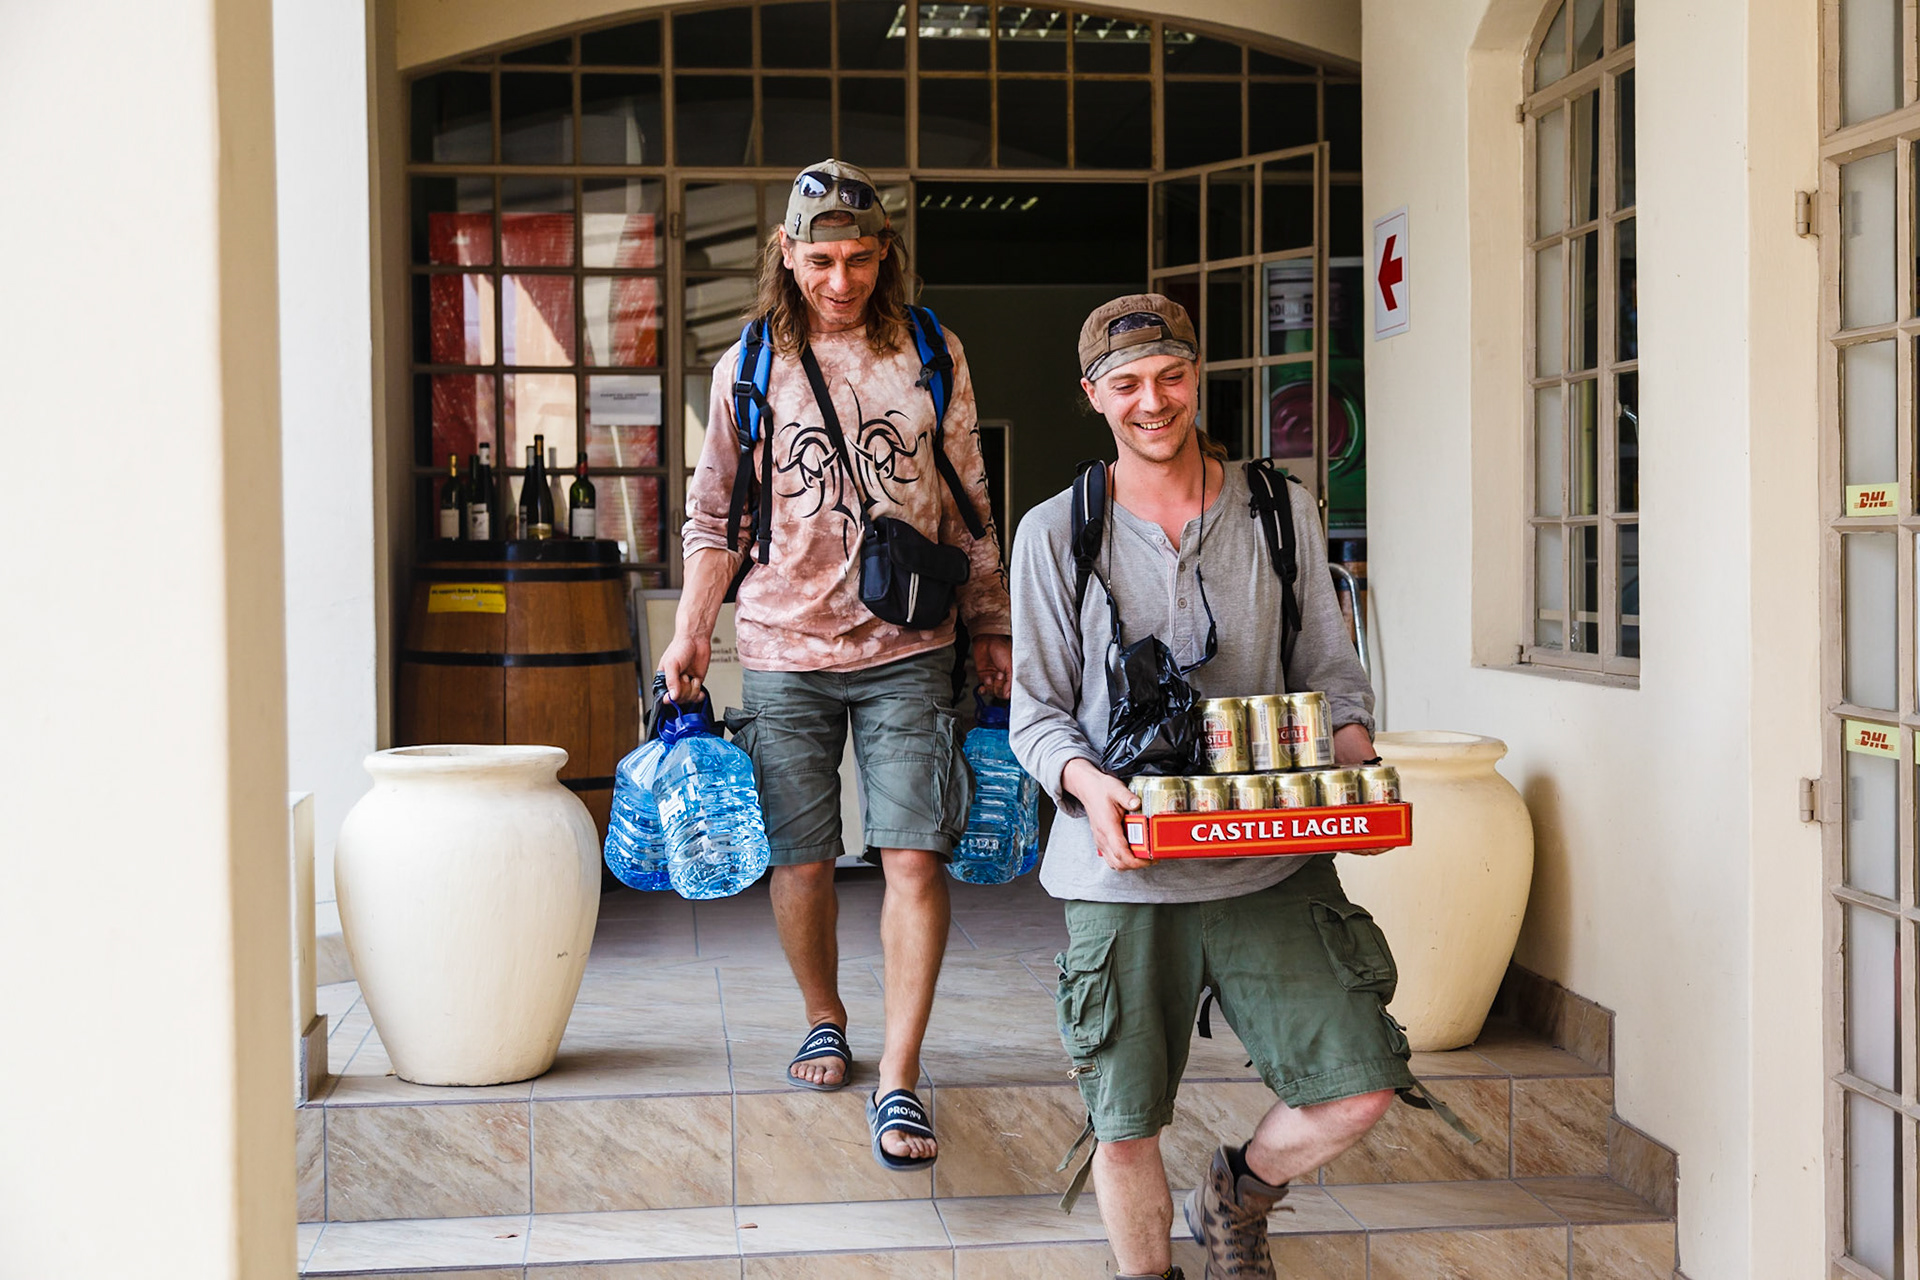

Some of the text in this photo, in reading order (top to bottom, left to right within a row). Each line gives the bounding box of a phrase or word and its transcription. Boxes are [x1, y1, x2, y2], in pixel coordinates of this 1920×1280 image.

[1859, 491, 1888, 508] DHL
[1860, 730, 1889, 750] DHL
[1191, 816, 1370, 842] CASTLE LAGER
